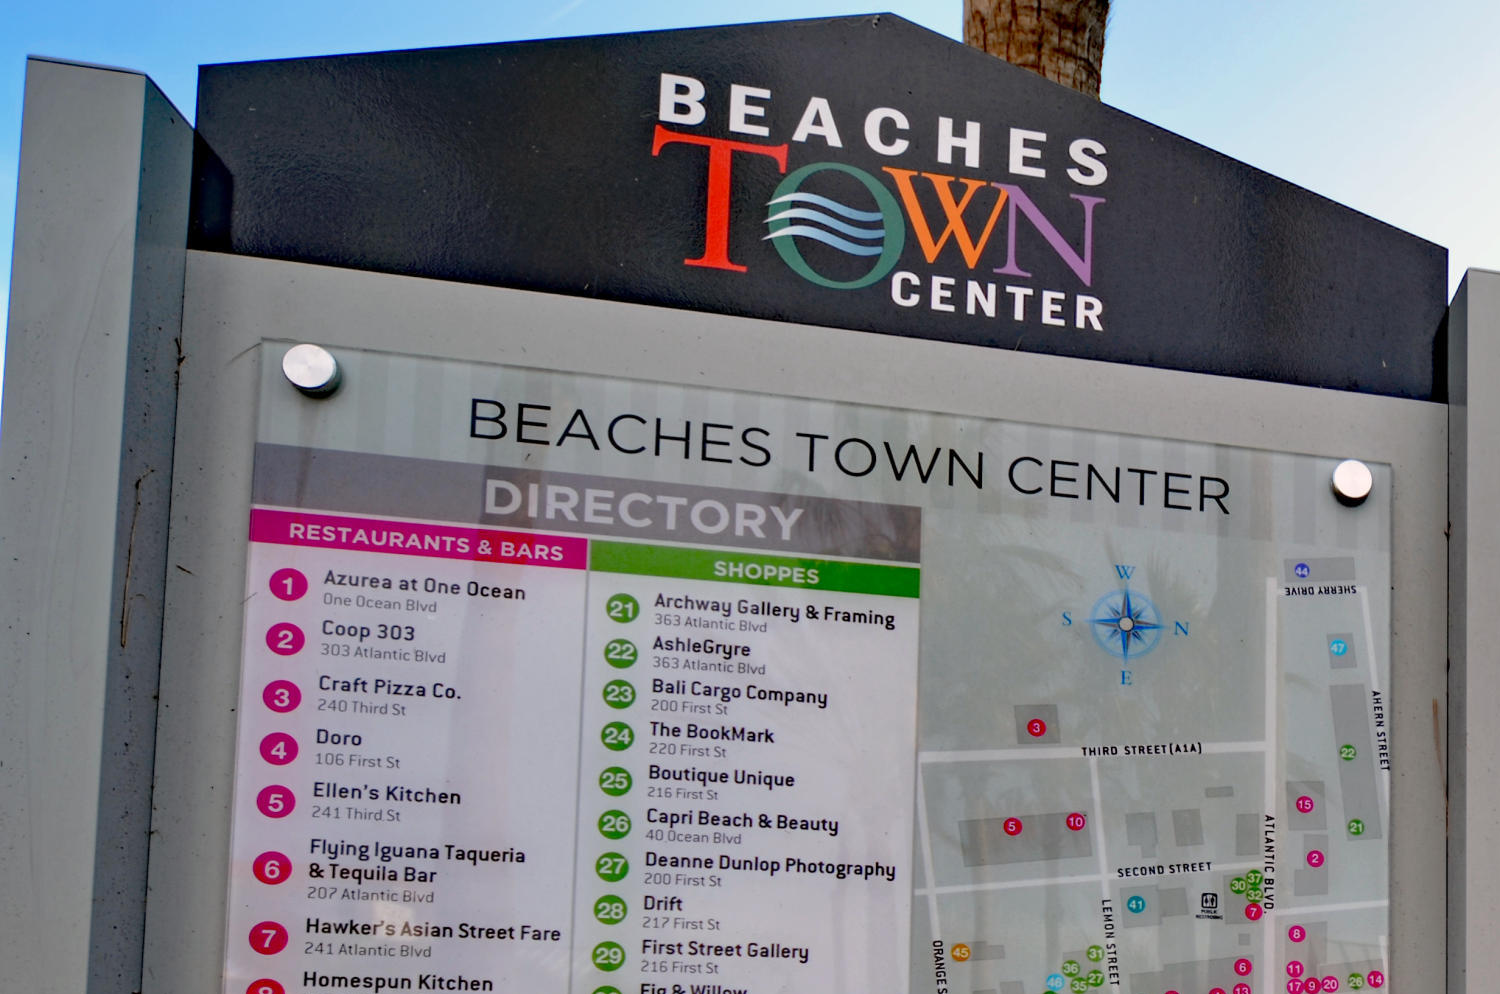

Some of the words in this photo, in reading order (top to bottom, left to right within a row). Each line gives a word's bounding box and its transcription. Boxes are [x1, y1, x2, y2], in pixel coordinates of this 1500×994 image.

[659, 73, 1107, 186] BEACHES
[652, 125, 1105, 289] TOWN
[891, 271, 1103, 331] CENTER
[470, 398, 772, 468] BEACHES
[796, 431, 985, 490] TOWN
[1008, 456, 1231, 515] CENTER
[484, 479, 804, 541] DIRECTORY
[289, 523, 470, 553] RESTAURANTS
[478, 540, 492, 555] &
[501, 541, 563, 561] BARS
[714, 561, 819, 584] SHOPPES
[1115, 566, 1136, 581] W
[282, 577, 292, 595] 1
[324, 571, 392, 589] Azurea
[399, 576, 417, 591] at
[424, 579, 460, 595] One
[467, 582, 526, 600] Ocean
[1285, 586, 1314, 596] DRIVE
[1318, 585, 1356, 594] SHERRY
[323, 593, 351, 607] One
[356, 595, 401, 610] Ocean
[406, 599, 437, 613] Blvd
[1062, 612, 1072, 626] S
[1174, 622, 1189, 636] N
[322, 621, 370, 642] Coop
[377, 625, 415, 641] 303
[321, 644, 350, 657] 303
[354, 646, 410, 661] Atlantic
[415, 650, 446, 663] Blvd
[653, 636, 751, 659] AshleGryre
[1121, 671, 1132, 685] E
[274, 690, 290, 706] 3
[319, 676, 367, 693] Craft
[375, 680, 426, 697] Pizza
[433, 683, 462, 699] Co.
[652, 679, 686, 695] Bali
[691, 682, 741, 702] Cargo
[747, 686, 827, 707] Company
[1372, 691, 1384, 727] AHERN
[317, 729, 362, 746] Doro
[650, 722, 681, 737] The
[687, 725, 775, 743] BookMark
[1082, 746, 1118, 756] THIRD
[1377, 732, 1390, 770] STREET
[313, 782, 379, 800] Ellen's
[386, 786, 461, 804] Kitchen
[1264, 815, 1275, 872] ATLANTIC
[1118, 866, 1164, 877] SECOND
[1169, 862, 1211, 873] STREET
[644, 896, 682, 911] Drift
[306, 919, 396, 936] Hawker's
[401, 922, 453, 938] Asian
[458, 923, 514, 940] Street
[521, 926, 560, 941] Fare
[1102, 900, 1115, 938] LEMON
[932, 940, 946, 984] ORANGE
[1106, 944, 1119, 985] STREET
[303, 972, 412, 993] Homespun
[418, 975, 493, 991] Kitchen
